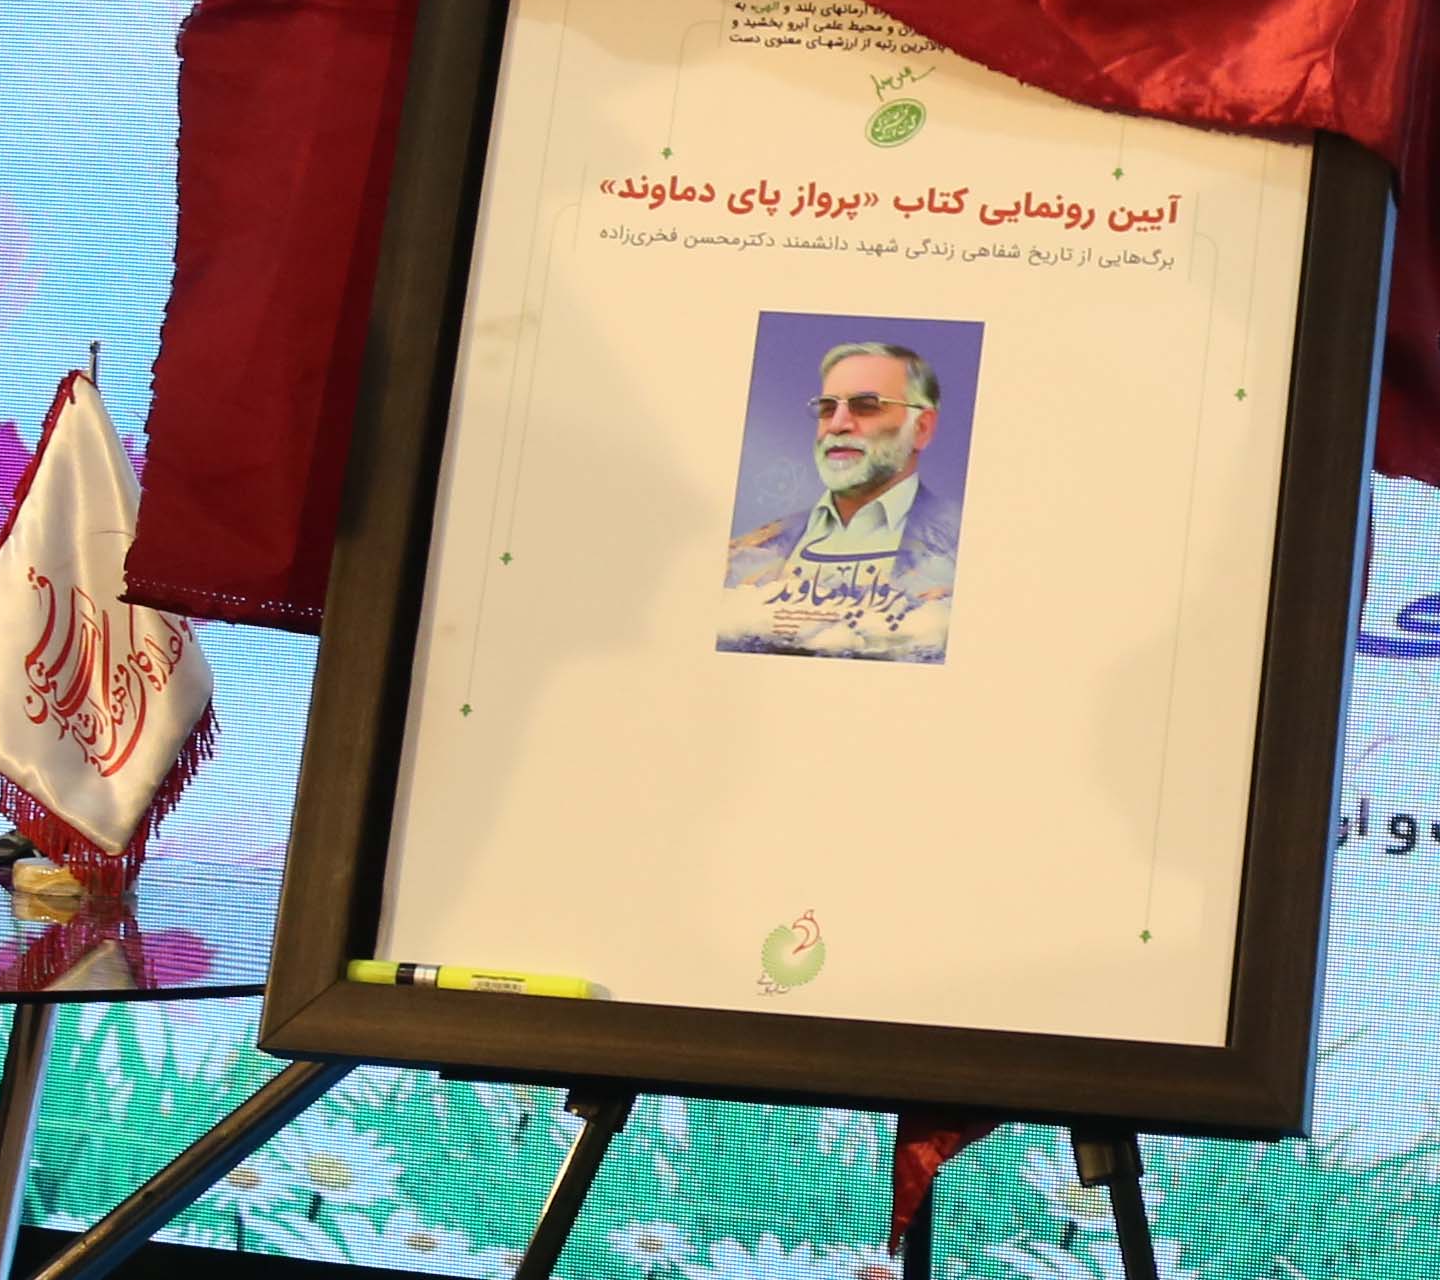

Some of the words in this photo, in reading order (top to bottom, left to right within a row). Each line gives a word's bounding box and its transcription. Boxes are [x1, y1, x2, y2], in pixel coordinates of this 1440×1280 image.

[600, 174, 716, 210] دماوند»
[727, 179, 781, 216] پای
[789, 180, 879, 220] «پرواز
[893, 187, 969, 219] کتاب
[979, 191, 1096, 231] رونمایی
[1107, 194, 1182, 232] آیین
[782, 234, 849, 252] دانشمند
[855, 236, 899, 257] شهید
[905, 238, 955, 260] زندگی
[962, 243, 1021, 263] شفاهی
[1028, 246, 1073, 266] تاریخ
[1078, 247, 1092, 267] از
[1385, 813, 1417, 856] و
